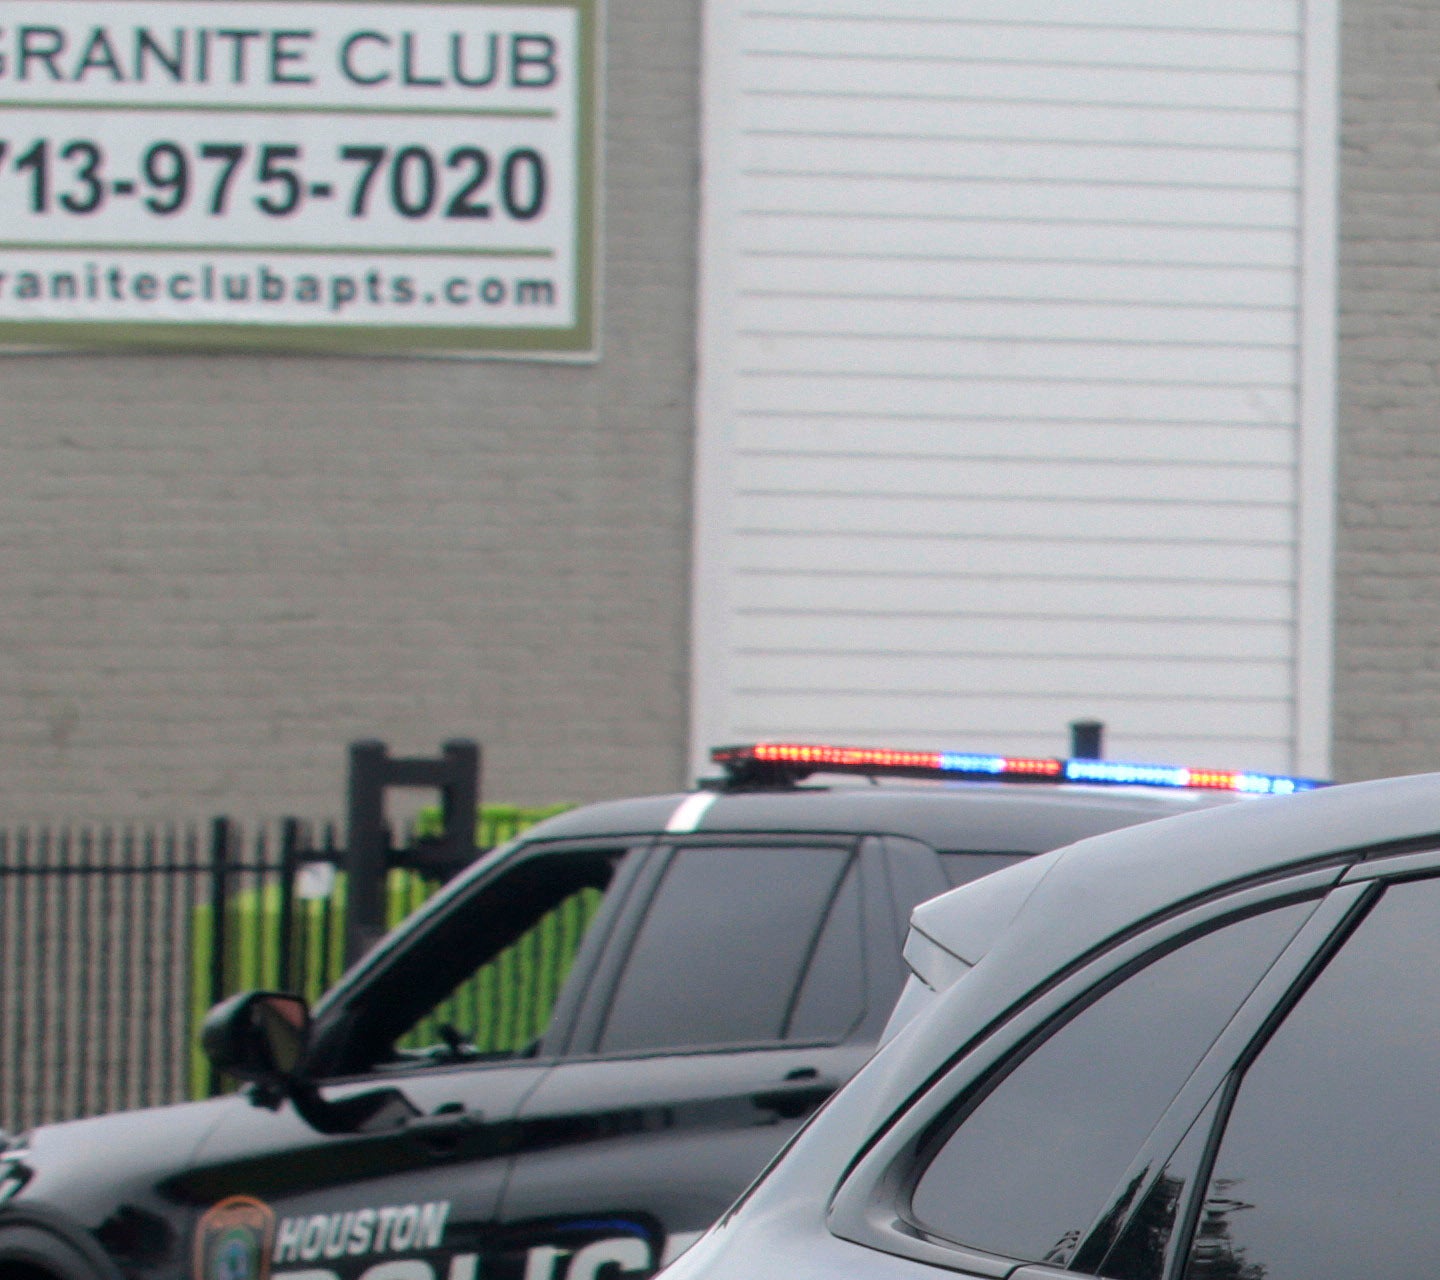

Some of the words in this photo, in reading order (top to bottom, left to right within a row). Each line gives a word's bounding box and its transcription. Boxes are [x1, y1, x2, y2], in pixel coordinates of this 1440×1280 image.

[0, 25, 313, 85] RANITE
[339, 29, 558, 89] CLUB
[0, 138, 547, 221] 13-975-7020
[0, 262, 556, 311] aniteclubapts.com
[274, 1202, 450, 1264] HOUSTON
